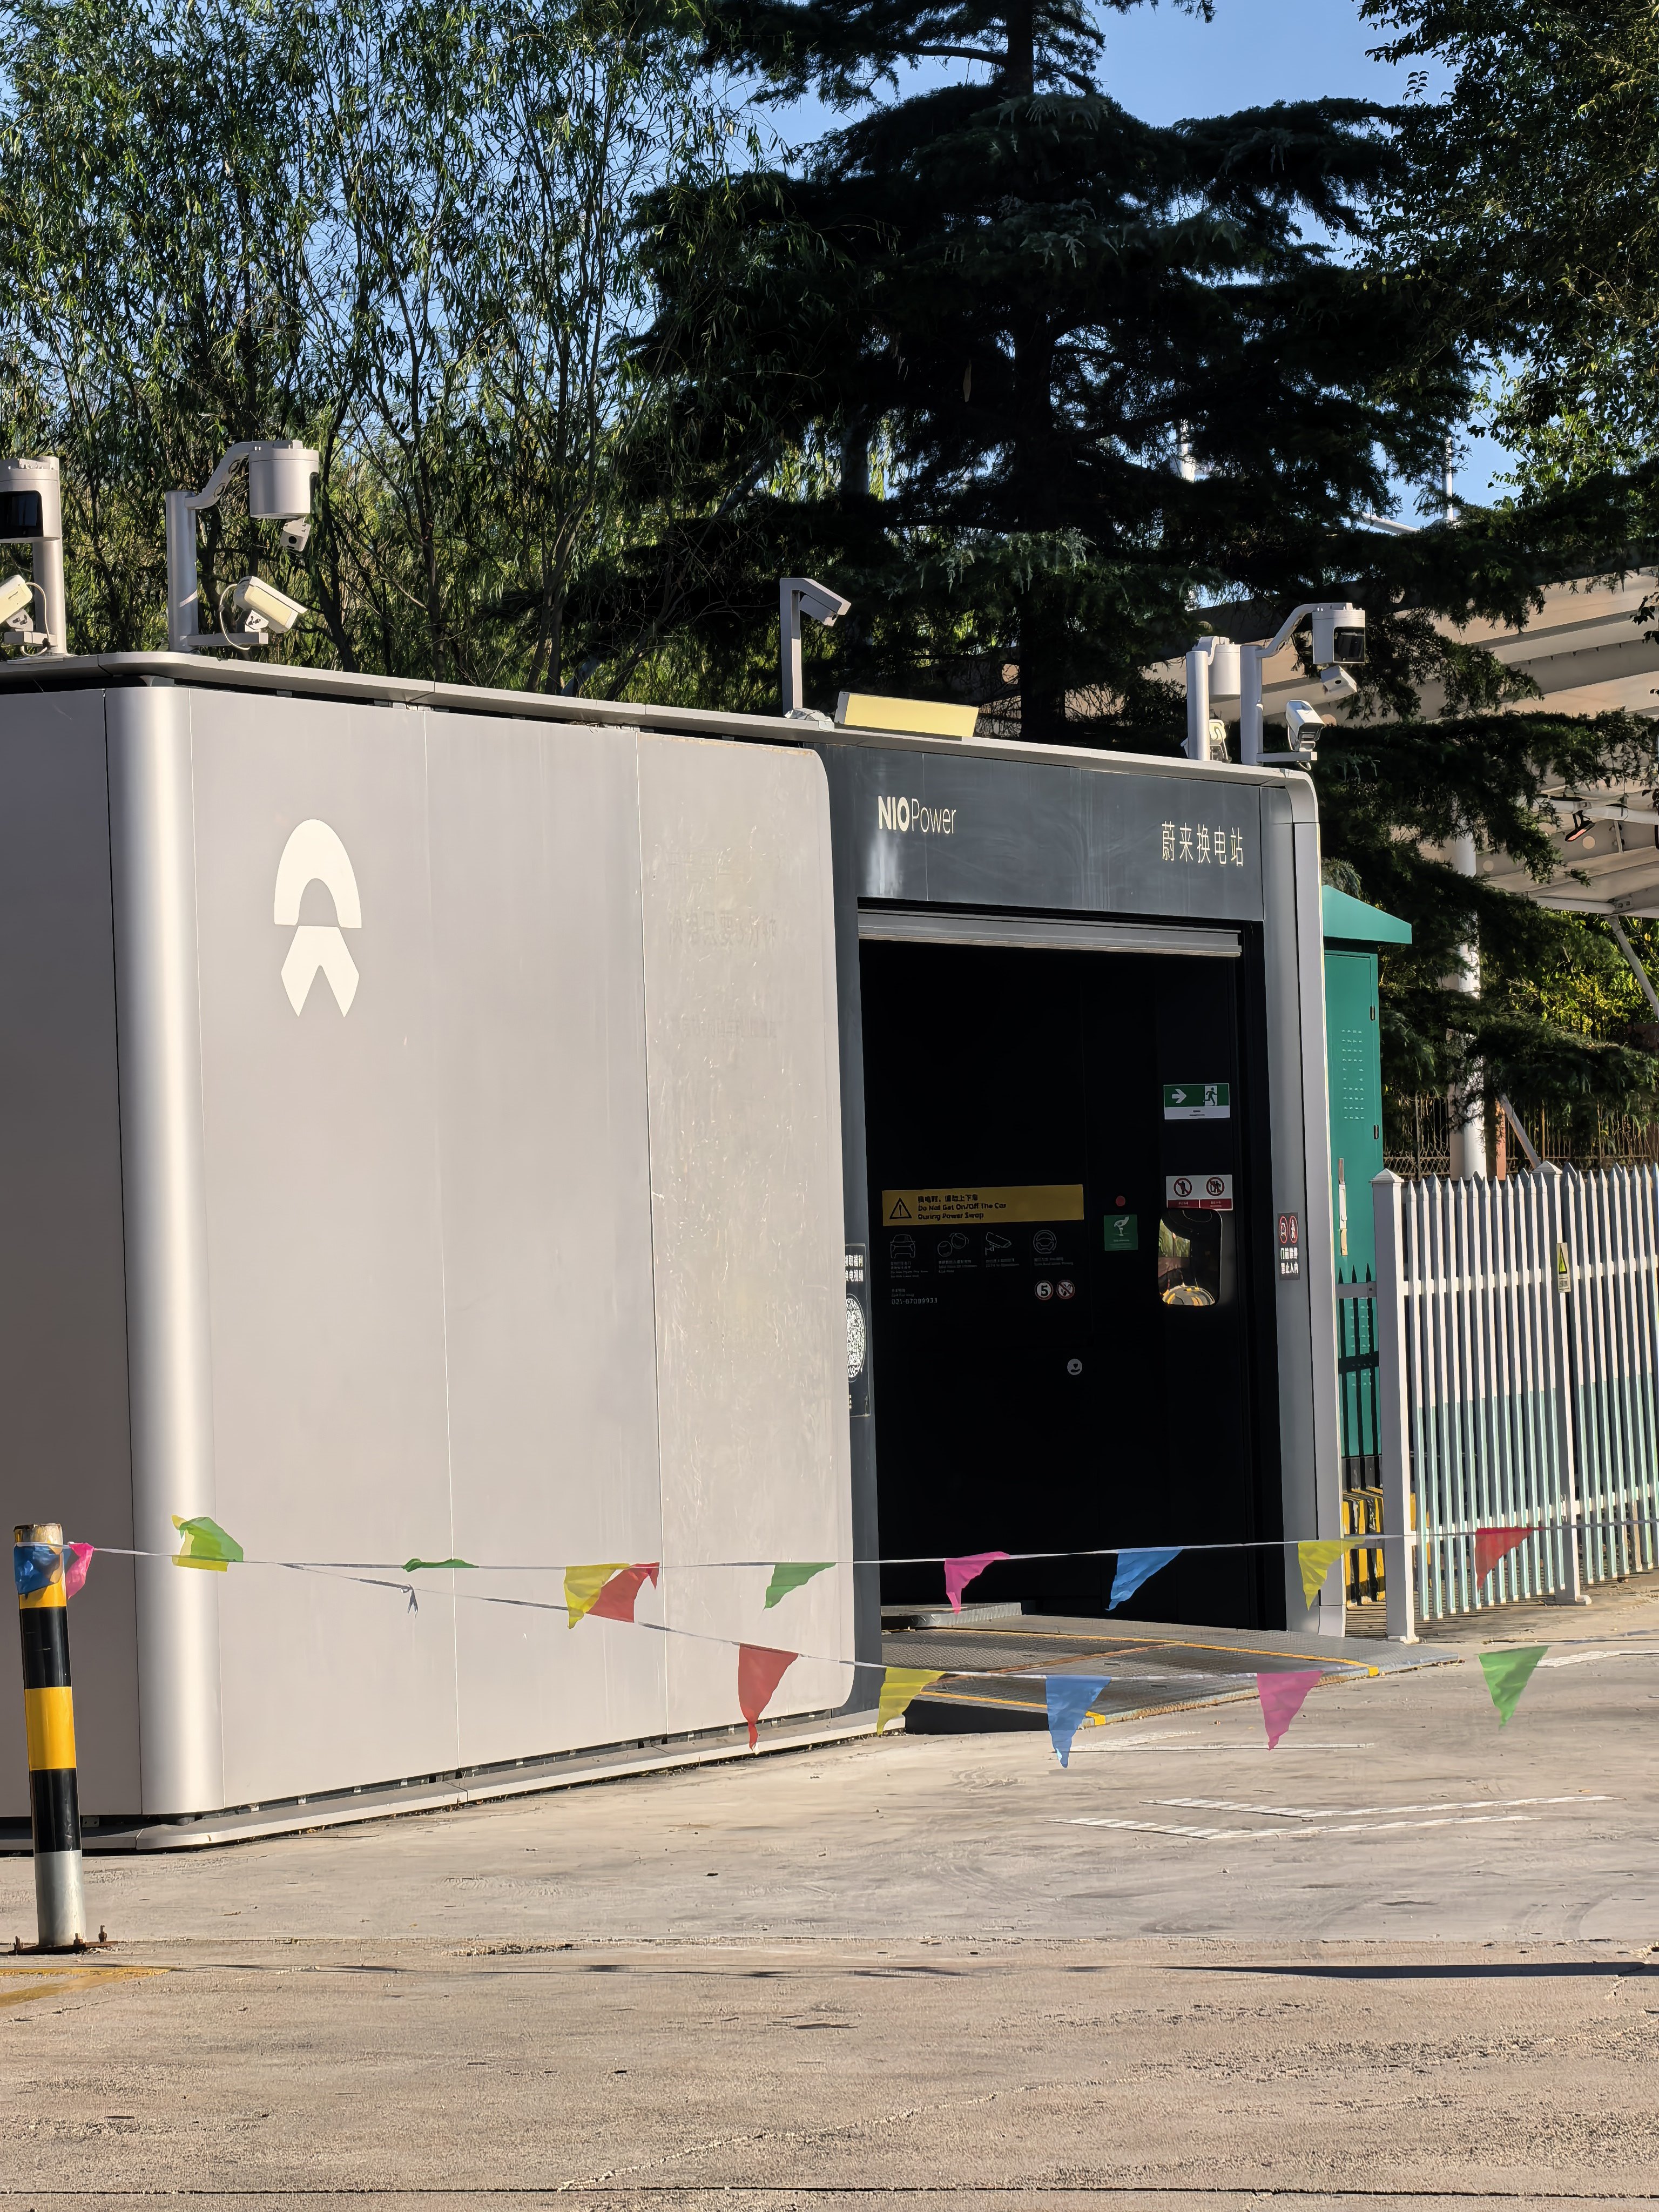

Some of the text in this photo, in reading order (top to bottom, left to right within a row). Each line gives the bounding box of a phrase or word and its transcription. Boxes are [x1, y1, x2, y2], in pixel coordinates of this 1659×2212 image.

[1161, 820, 1243, 867] 蔚来换电站
[1041, 1285, 1048, 1297] 5
